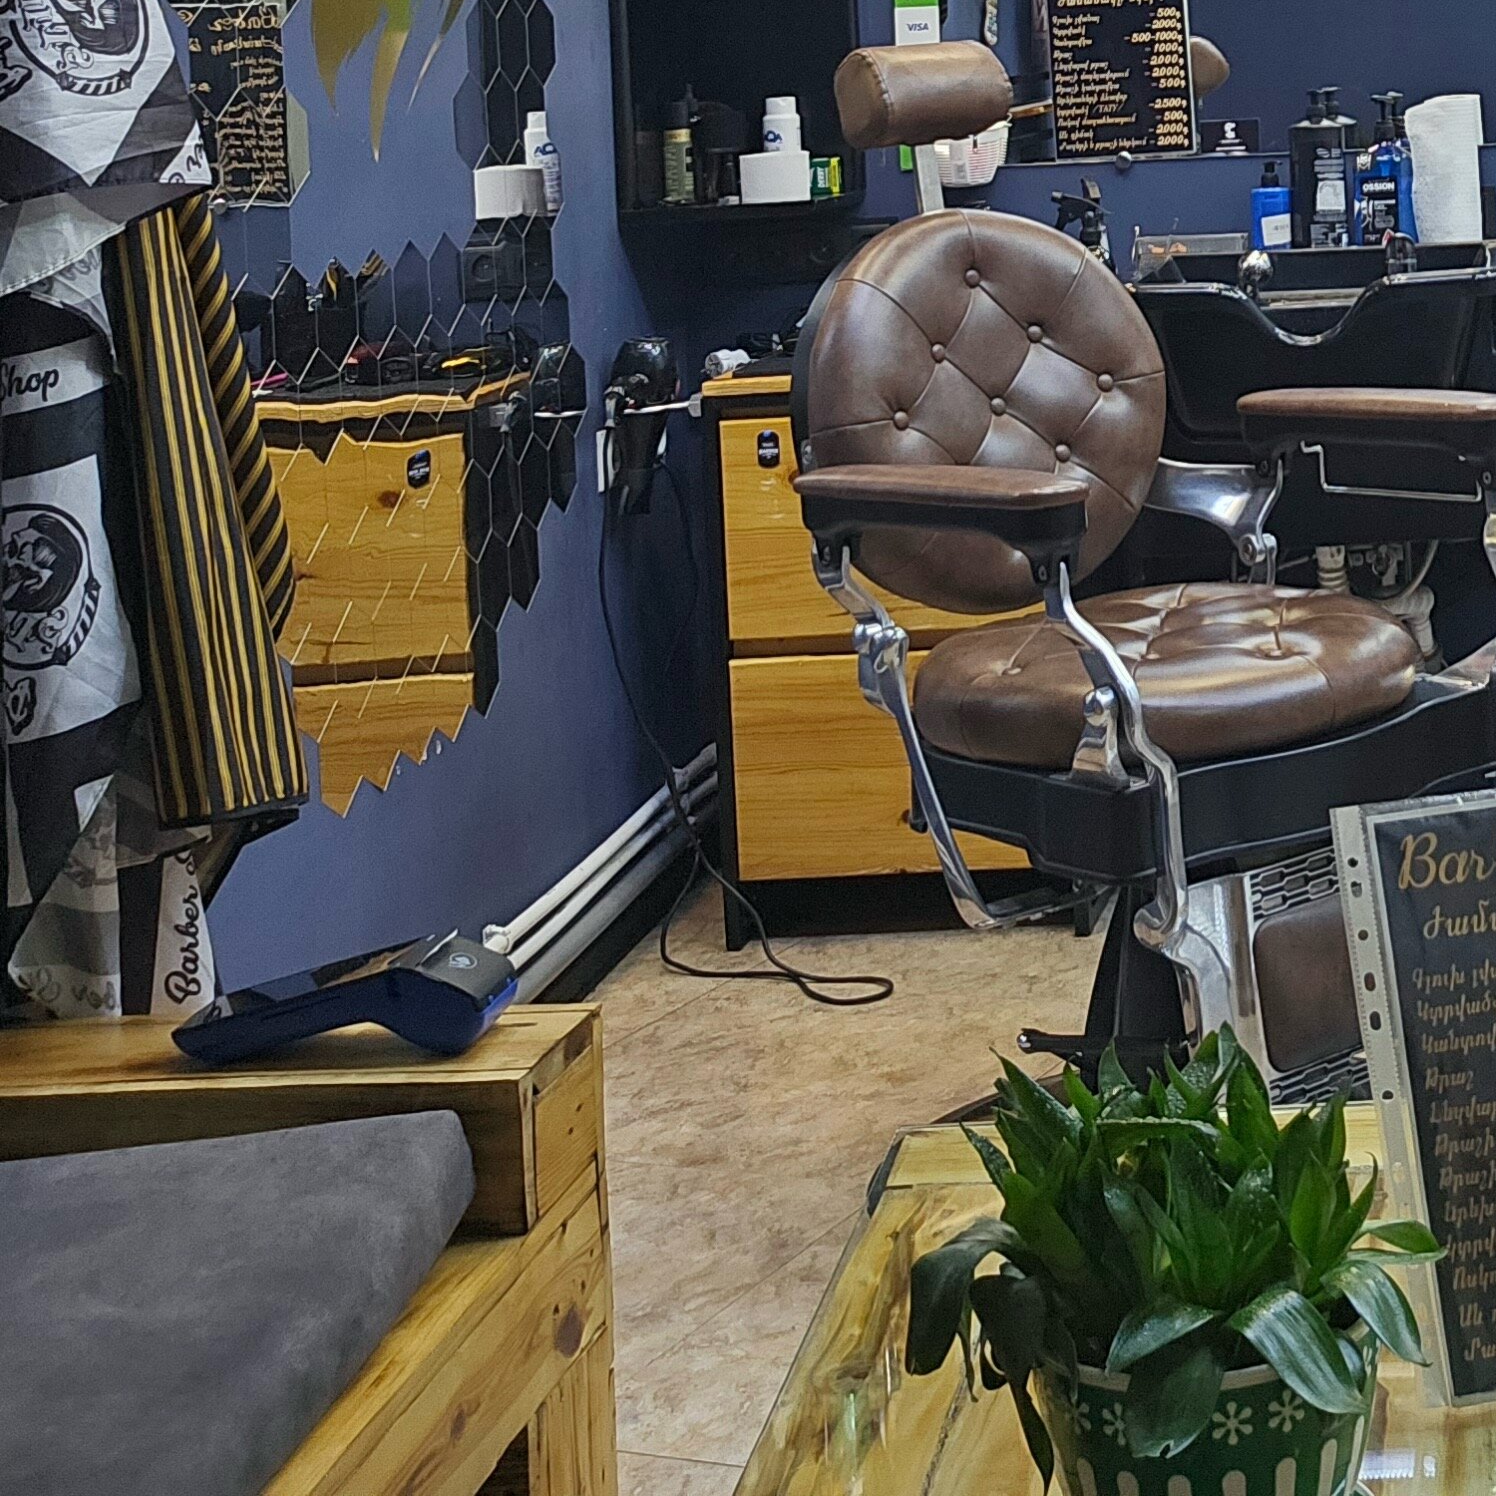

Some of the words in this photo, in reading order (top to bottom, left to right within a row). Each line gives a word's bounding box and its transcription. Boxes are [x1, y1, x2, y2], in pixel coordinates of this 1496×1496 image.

[907, 22, 929, 32] VISA
[1362, 181, 1395, 192] OSSION
[163, 884, 202, 1005] Barber
